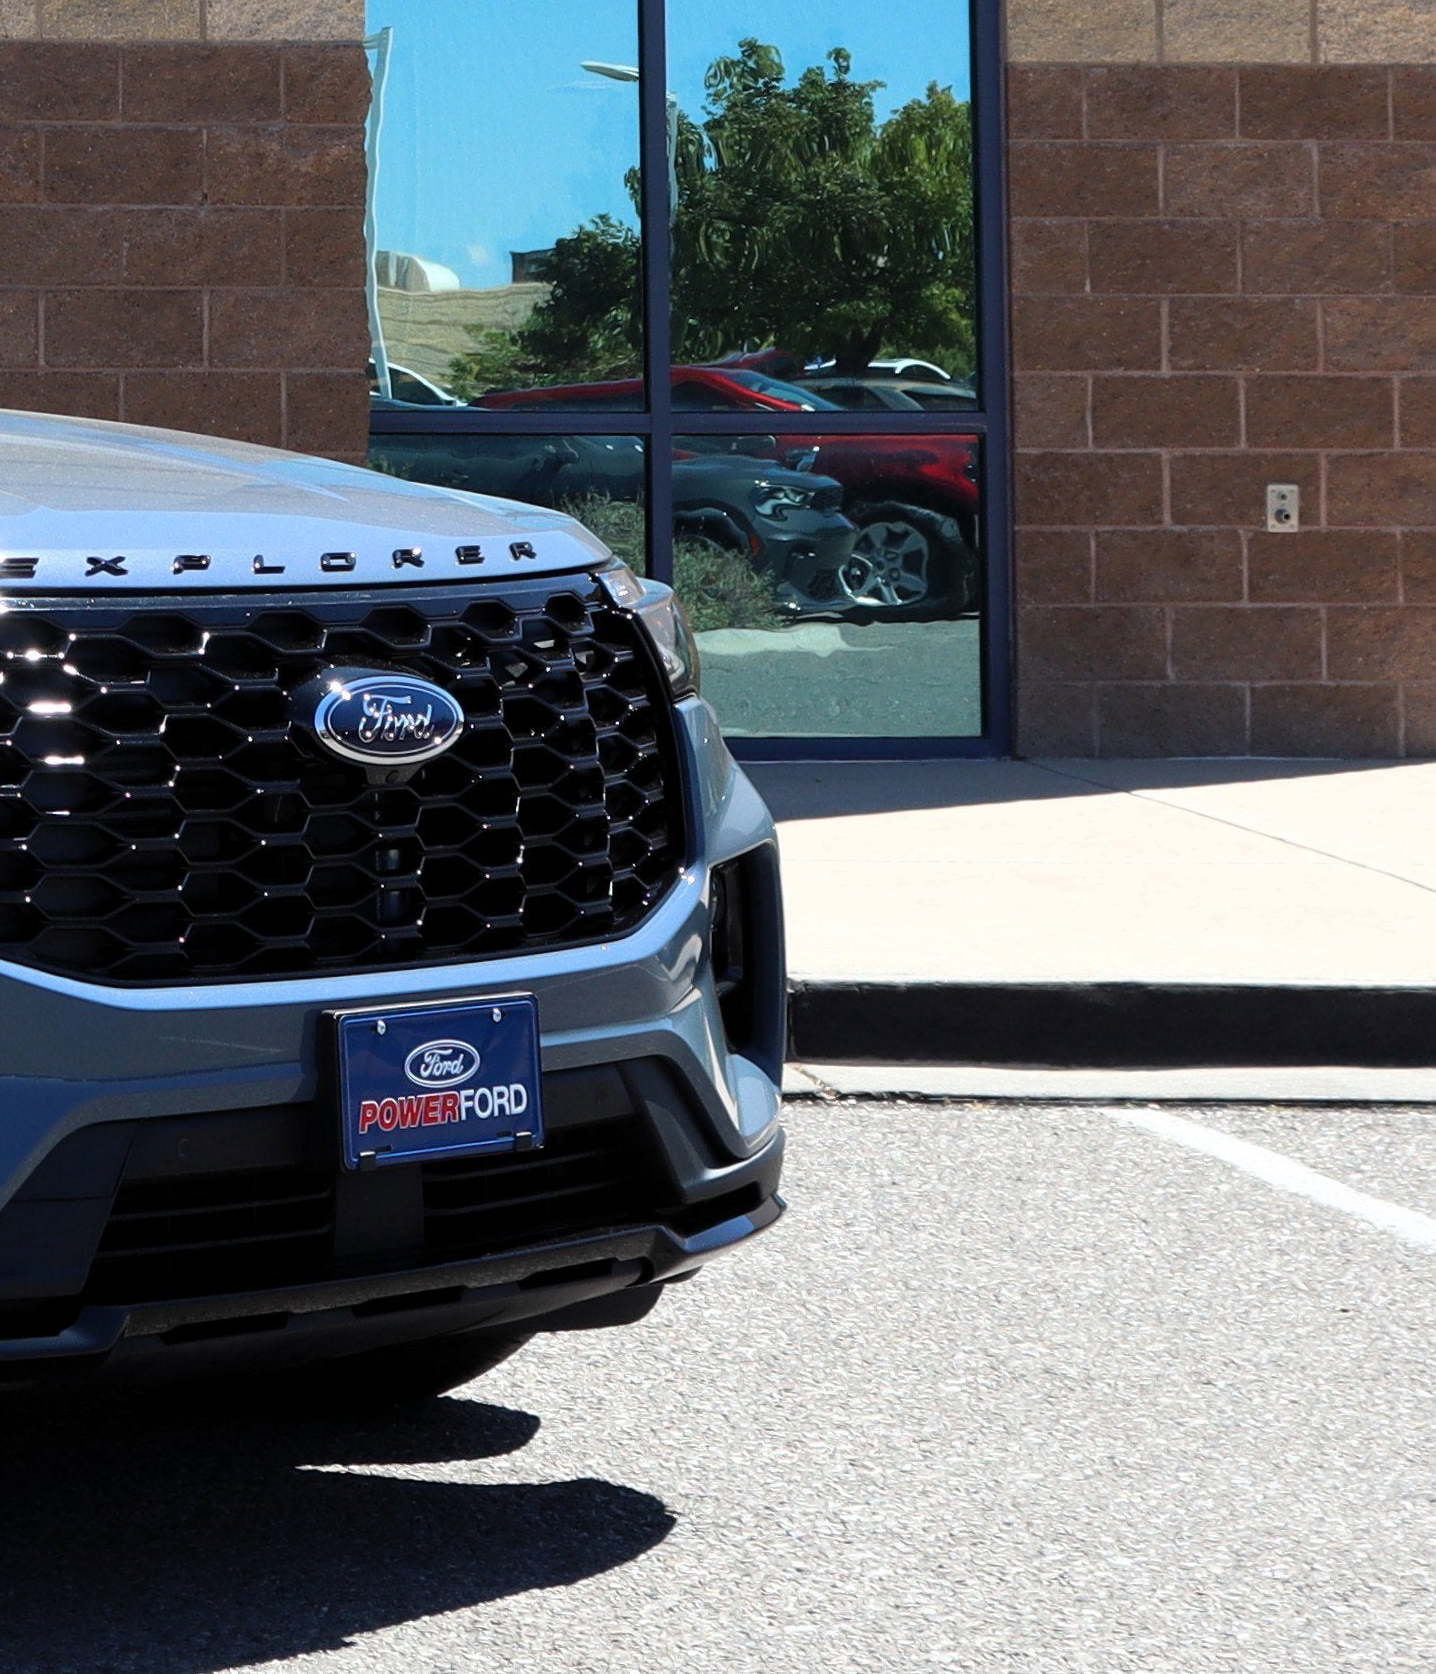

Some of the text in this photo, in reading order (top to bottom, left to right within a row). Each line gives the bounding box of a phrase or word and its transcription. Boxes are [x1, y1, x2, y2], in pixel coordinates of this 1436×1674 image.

[358, 695, 433, 744] Ford
[420, 1048, 465, 1078] Ford
[358, 1083, 528, 1135] POWERFORD
